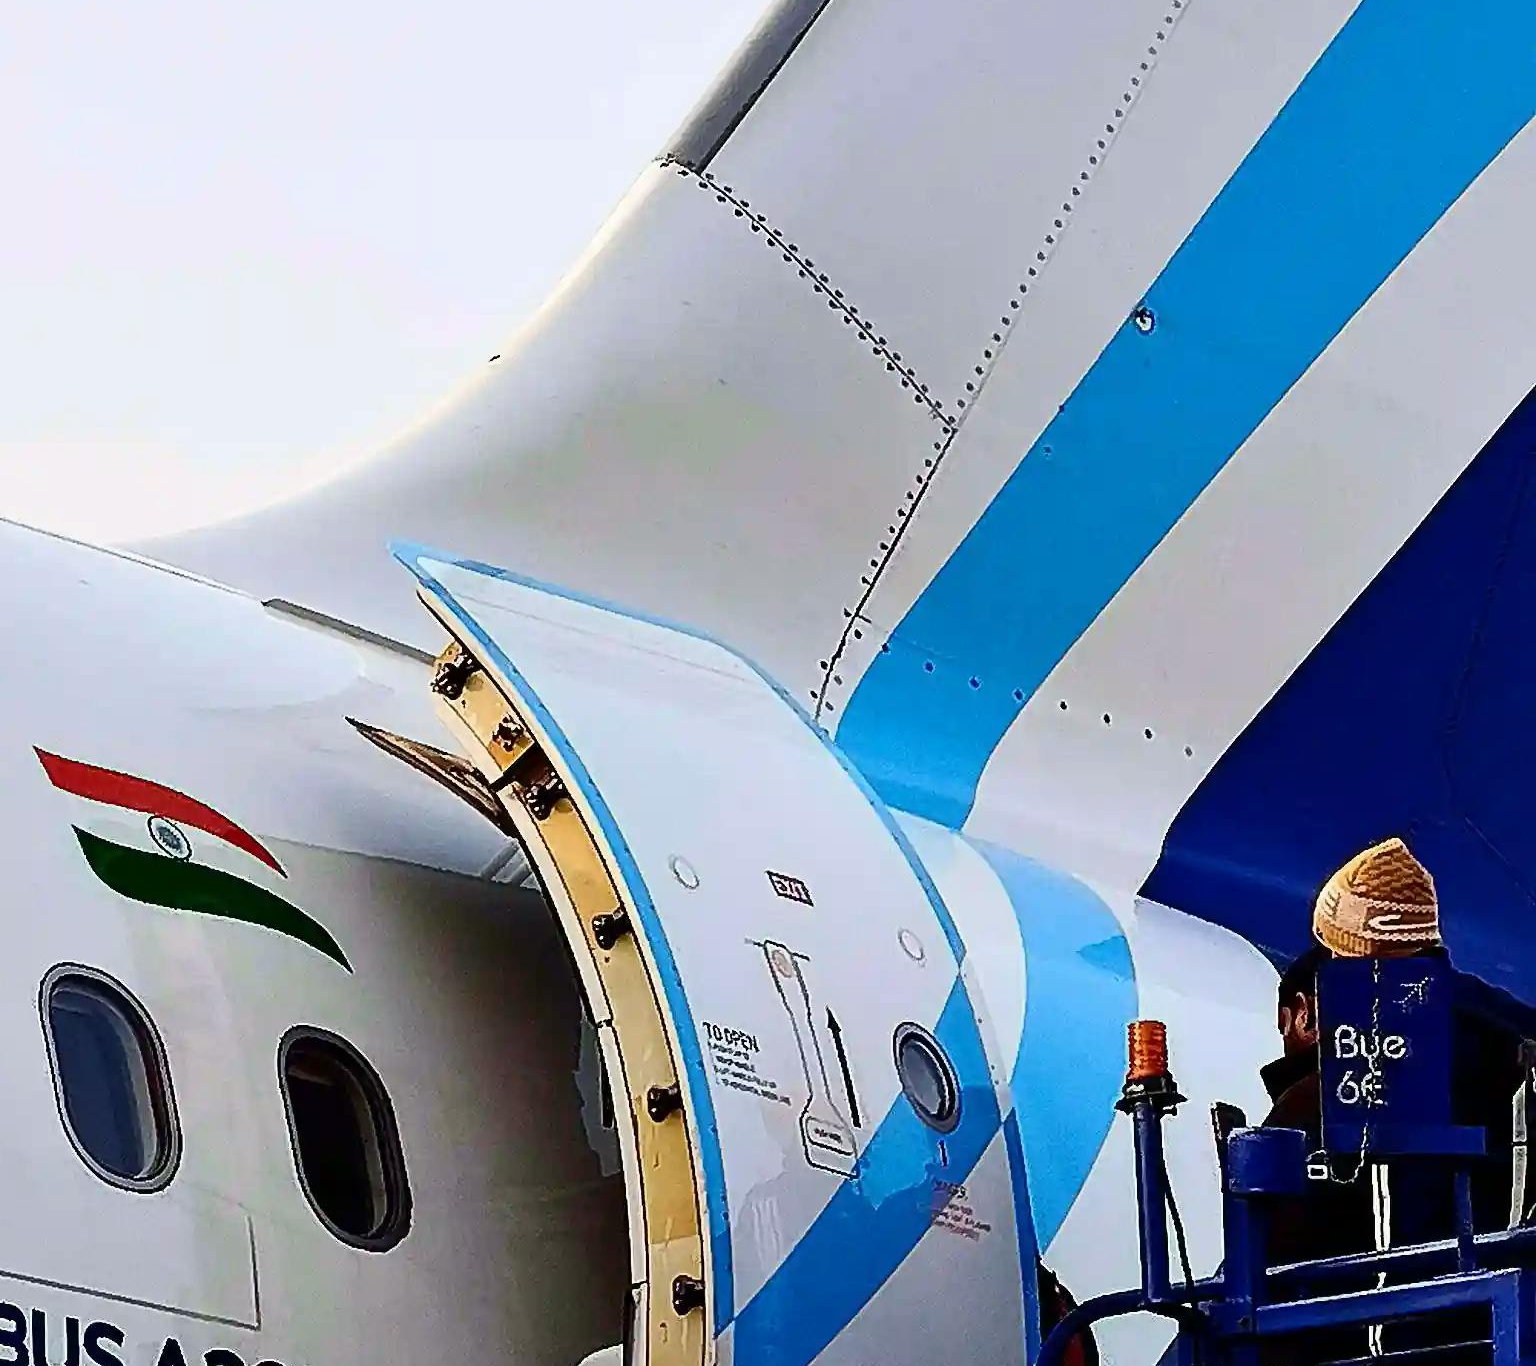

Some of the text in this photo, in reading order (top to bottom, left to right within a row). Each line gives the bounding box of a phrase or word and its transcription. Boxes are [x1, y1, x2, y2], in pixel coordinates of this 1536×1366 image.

[703, 1022, 723, 1041] TO
[724, 1028, 760, 1053] OPEN
[1336, 1070, 1383, 1106] 6E
